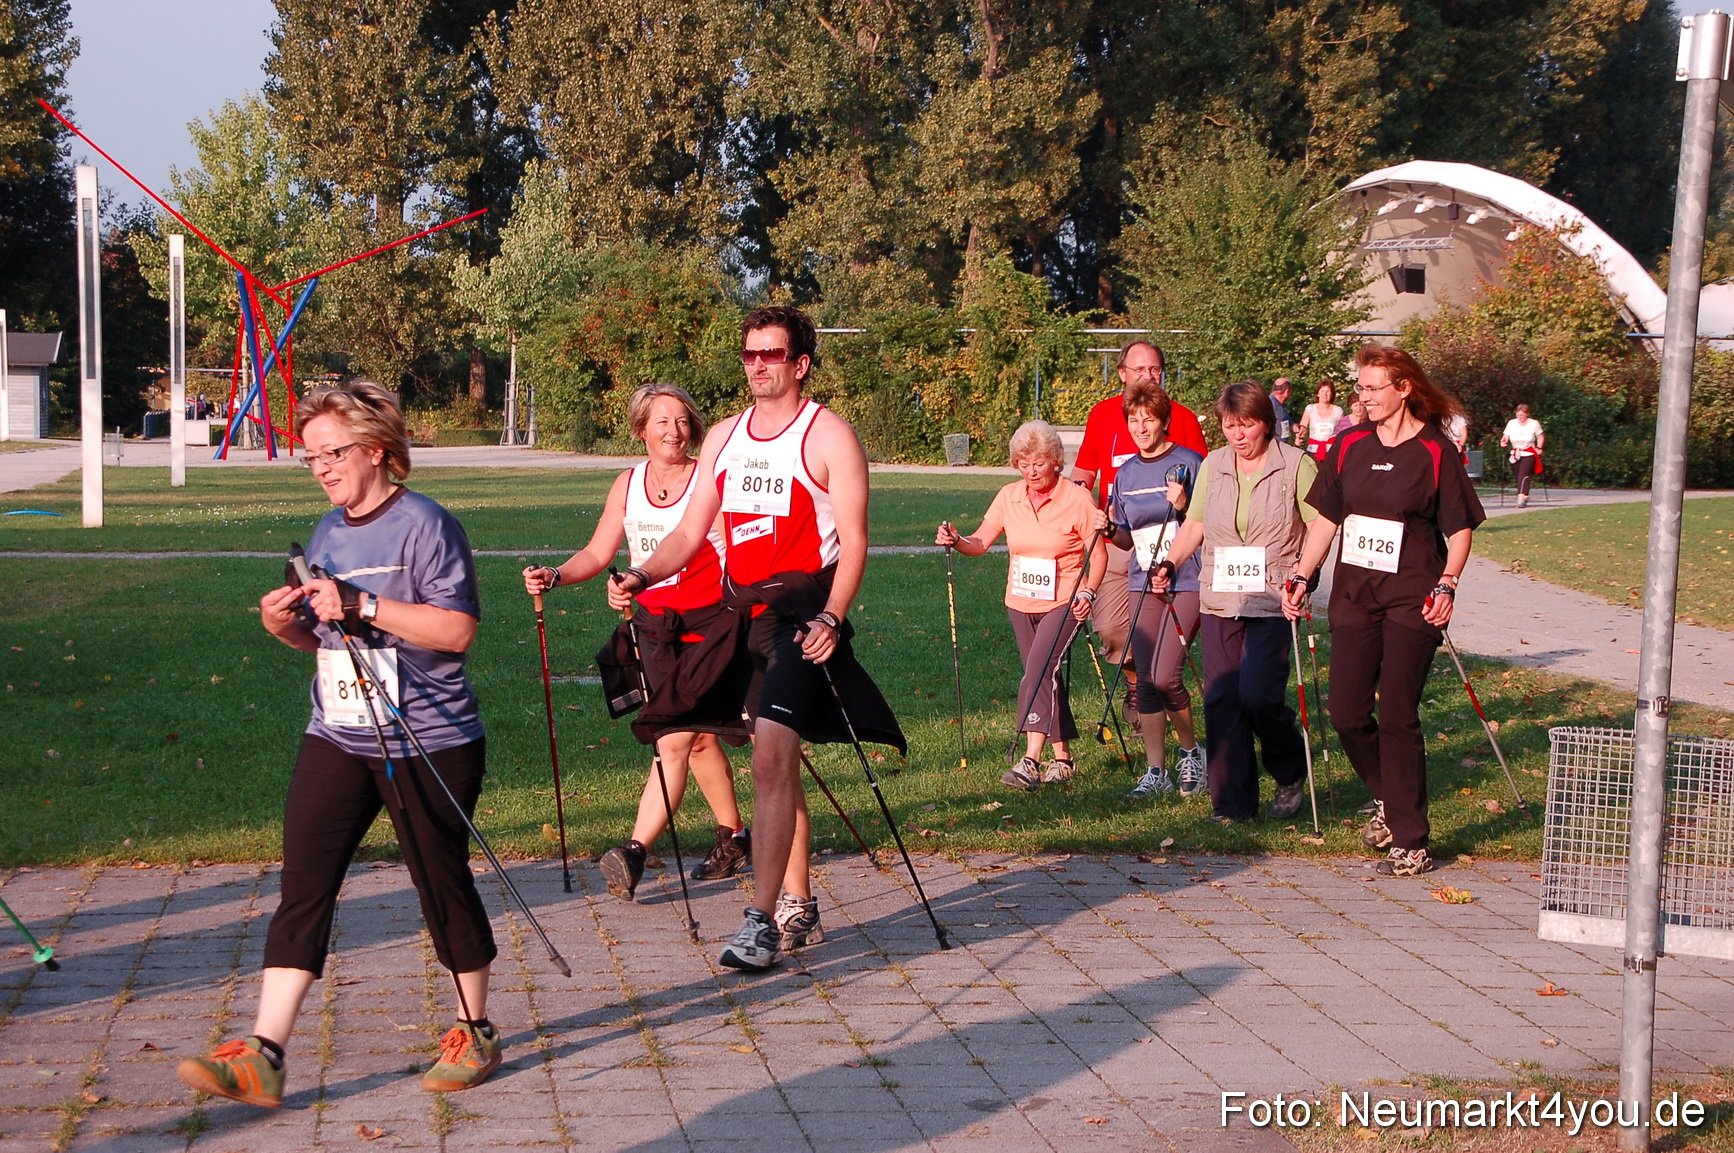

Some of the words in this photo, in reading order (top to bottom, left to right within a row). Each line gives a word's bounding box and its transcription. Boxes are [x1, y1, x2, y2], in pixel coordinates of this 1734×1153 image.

[744, 458, 770, 470] Jakob
[742, 475, 784, 495] 8018
[637, 521, 665, 532] Bettina
[741, 524, 760, 538] DEHN
[1149, 538, 1175, 555] 810
[1358, 535, 1394, 555] 8126
[1227, 564, 1260, 577] 8125
[1021, 572, 1051, 587] 8099
